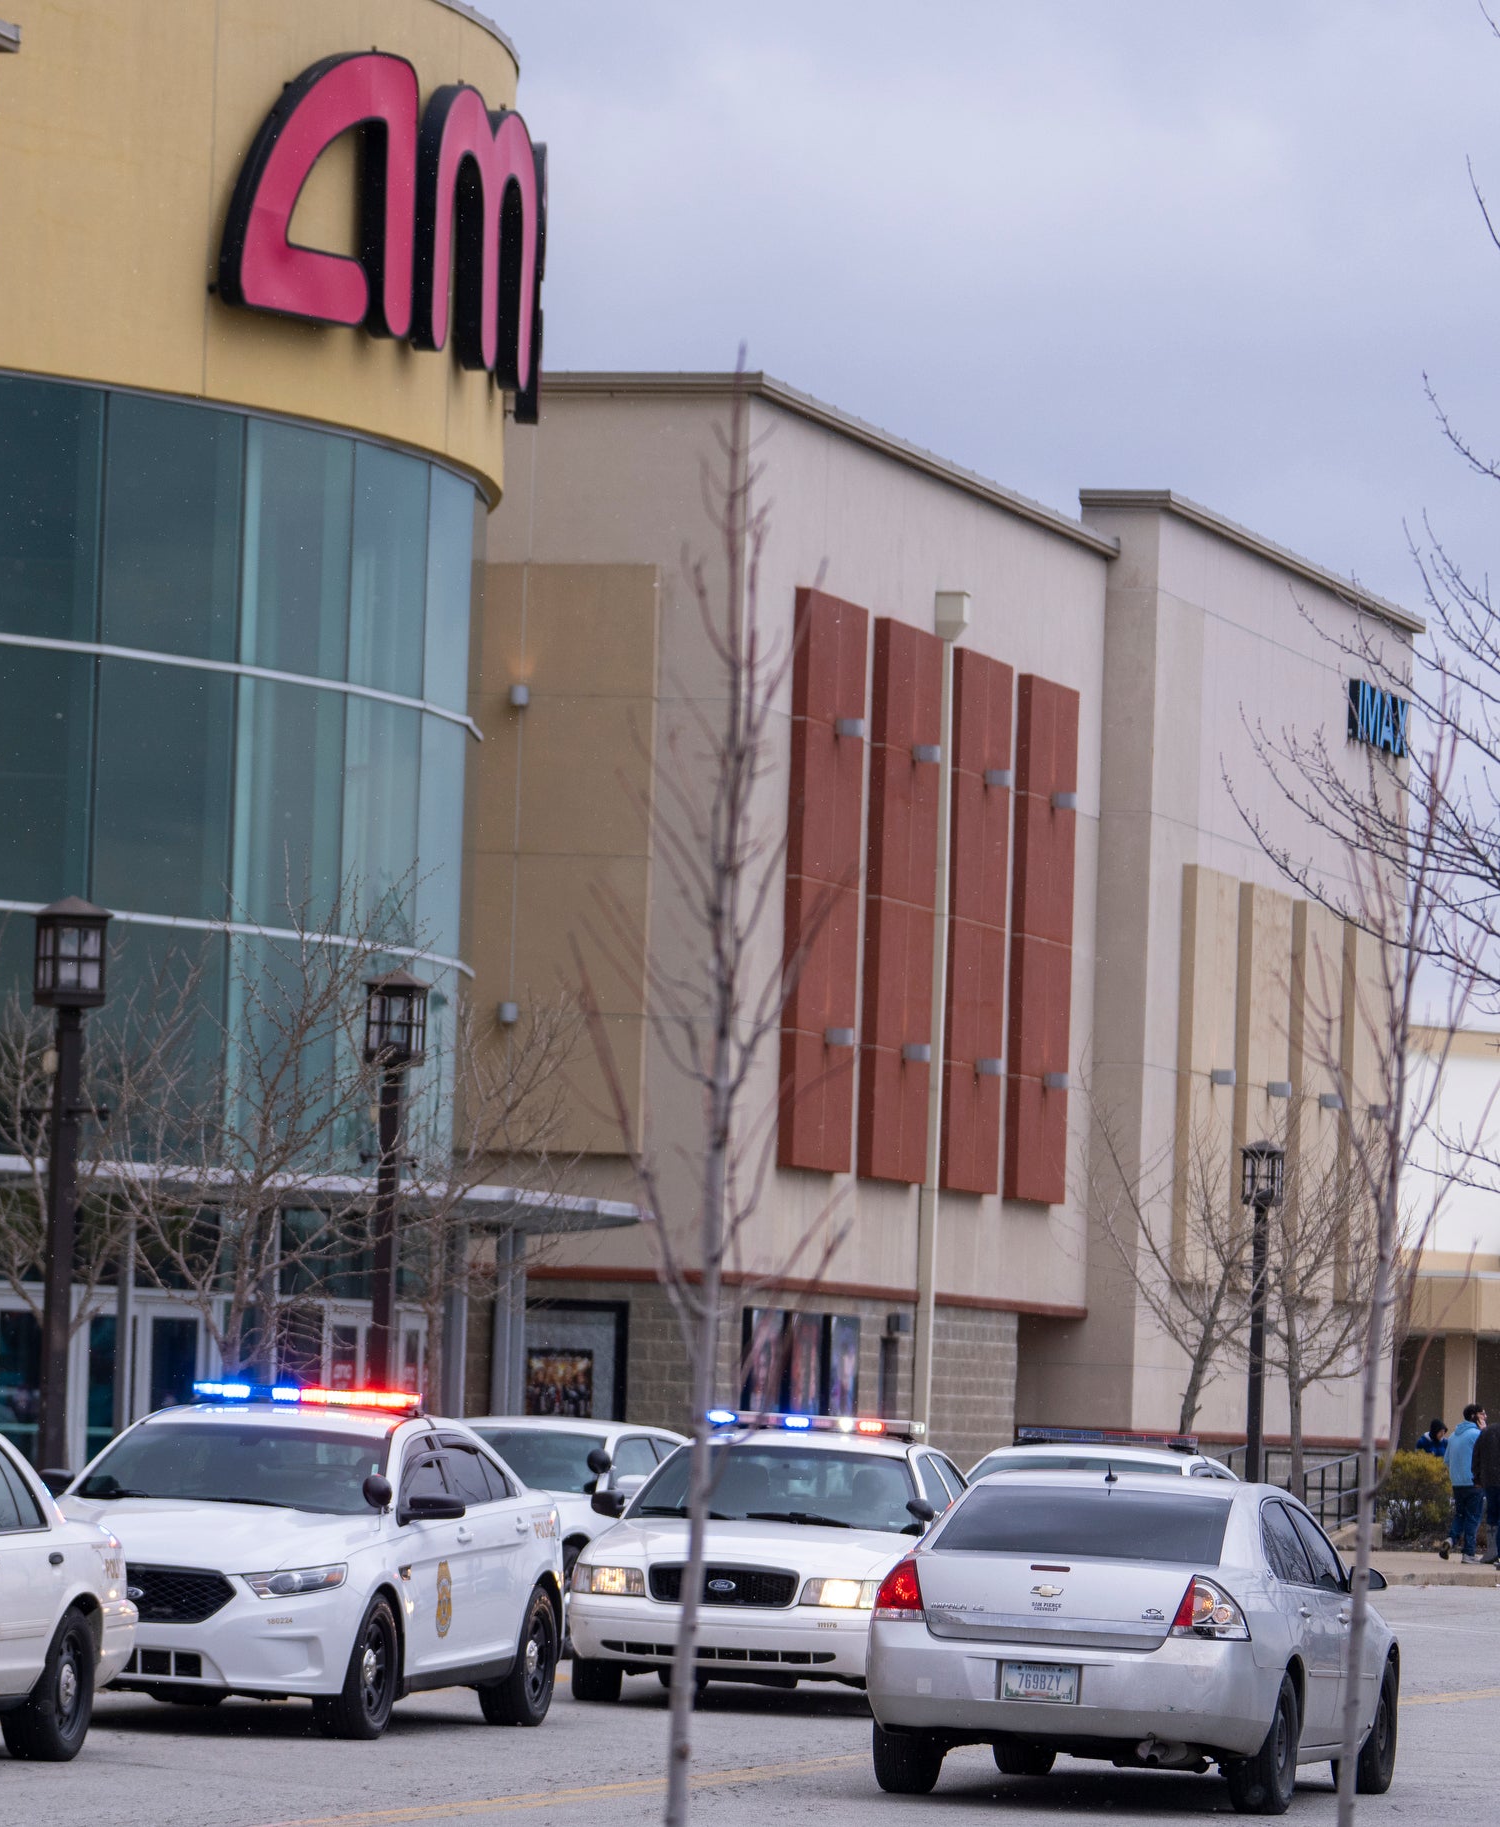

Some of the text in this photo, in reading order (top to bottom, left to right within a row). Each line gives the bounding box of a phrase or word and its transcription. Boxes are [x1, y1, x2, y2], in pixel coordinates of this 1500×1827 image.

[1353, 679, 1409, 758] IMAX
[931, 1601, 967, 1610] IMPALA
[1023, 1664, 1056, 1673] INDIANA
[1018, 1672, 1063, 1692] 769BZY
